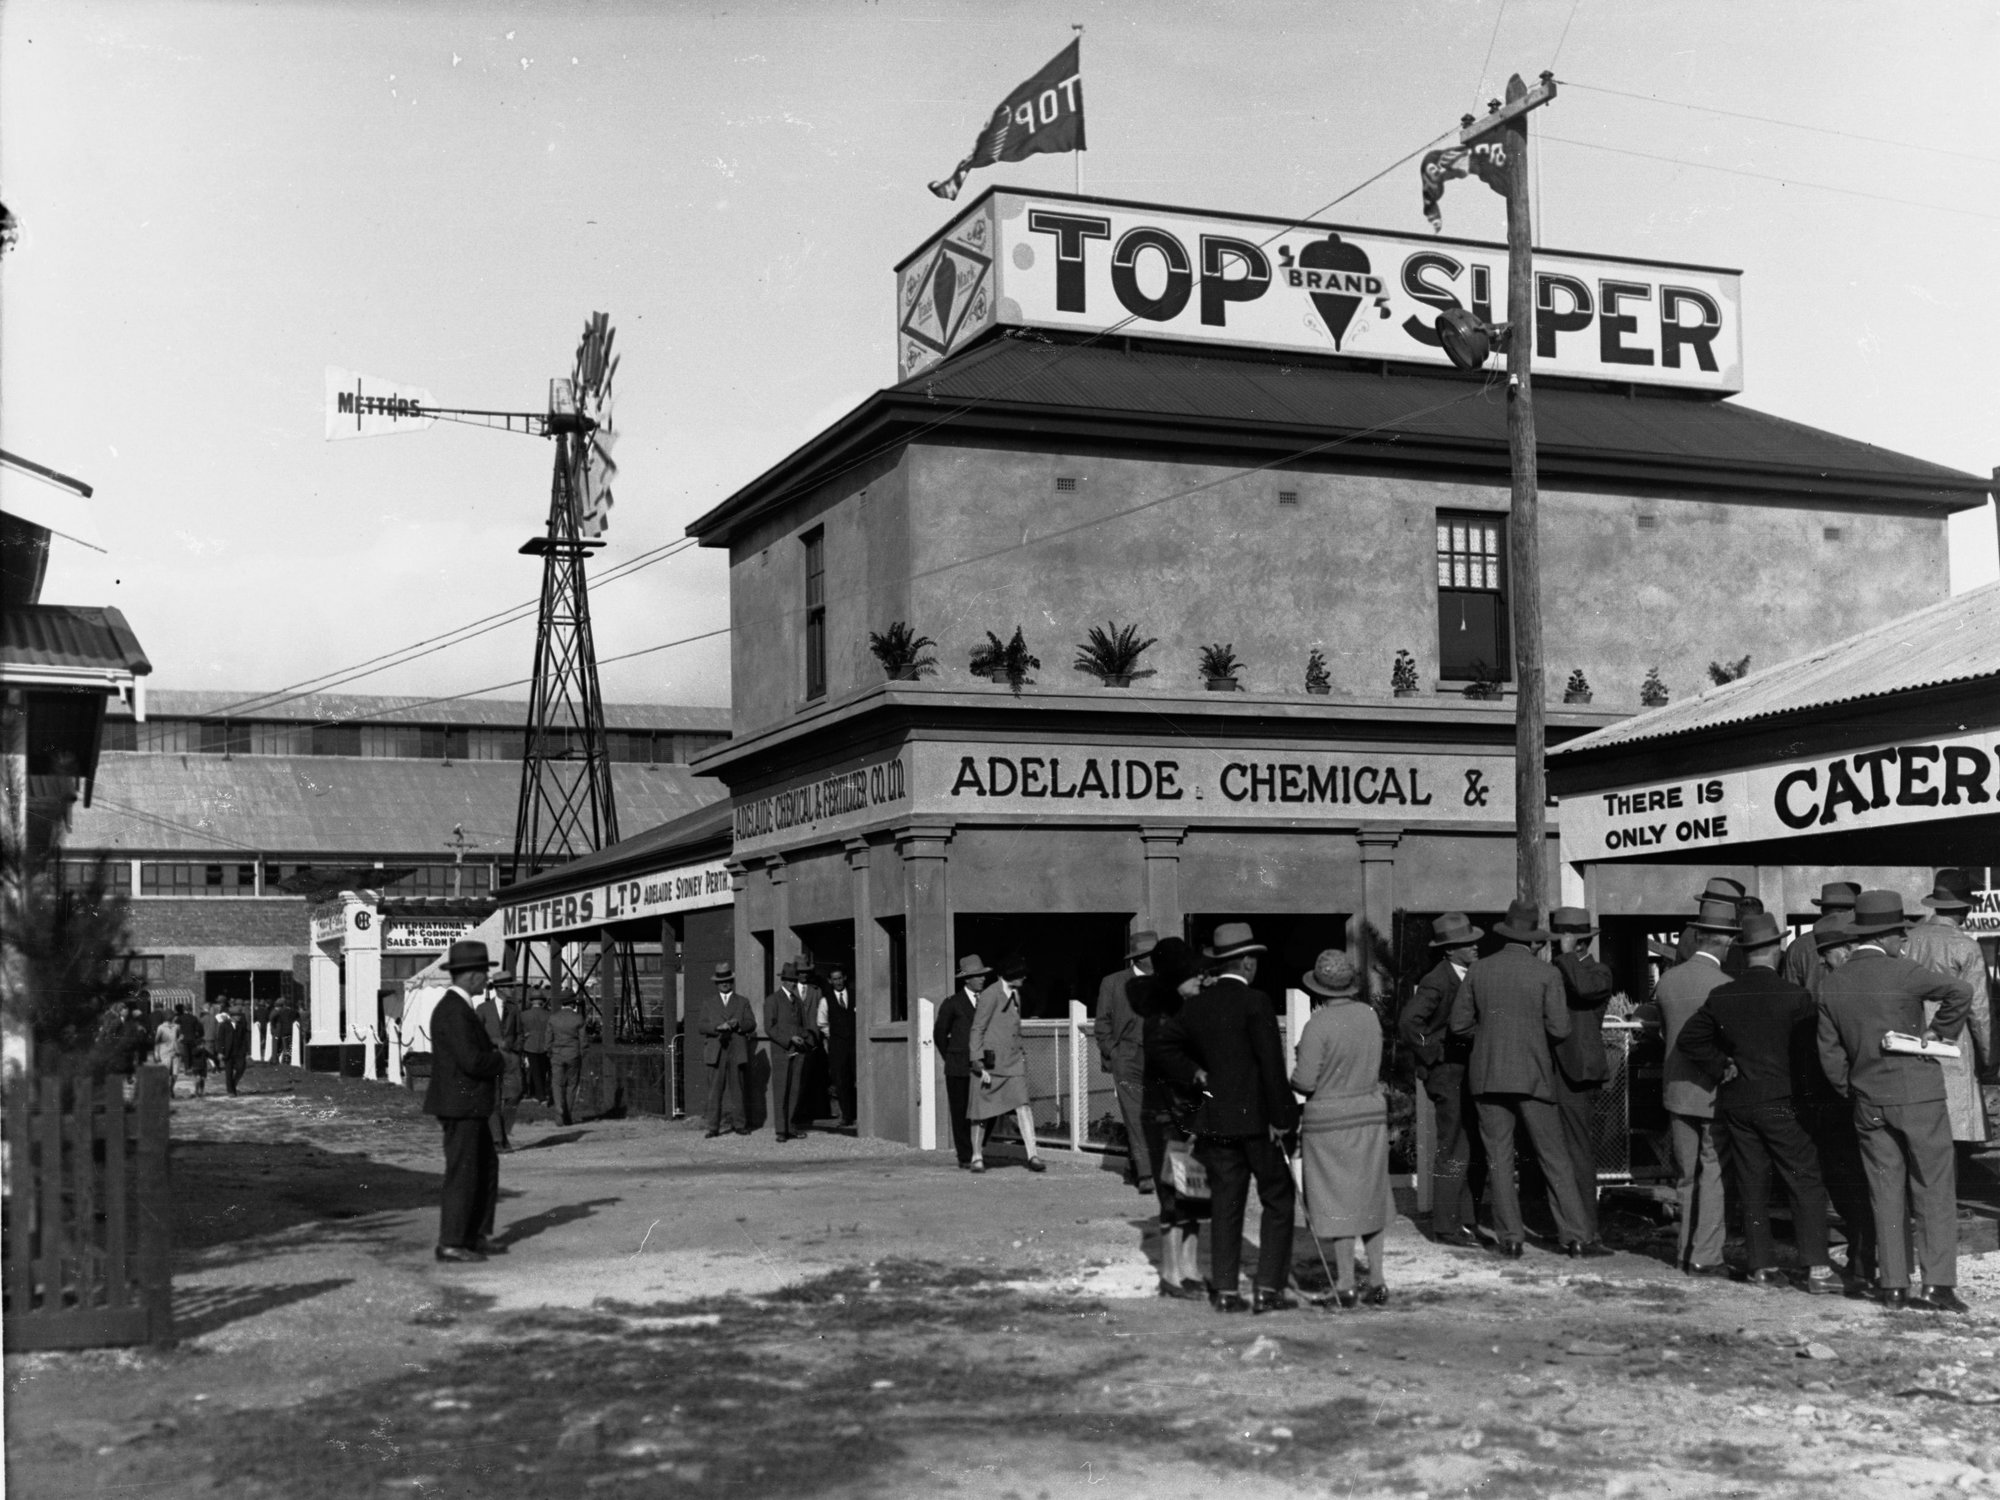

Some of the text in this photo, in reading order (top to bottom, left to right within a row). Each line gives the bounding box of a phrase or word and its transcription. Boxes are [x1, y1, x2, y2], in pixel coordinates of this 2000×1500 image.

[1029, 208, 1272, 327] TOP
[1288, 269, 1382, 294] BRAND
[338, 392, 420, 417] METTERS
[951, 757, 1490, 807] ADELAIDE CHEMICAL &
[1604, 780, 1724, 816] THERE IS
[1774, 744, 2000, 830] CATER
[735, 798, 774, 841] ADELAIDE
[774, 786, 813, 830] CHEMICAL
[1605, 816, 1728, 850] ONLY ONE
[389, 921, 467, 930] INTERNATIONAL
[503, 891, 594, 936] METTERS
[644, 880, 672, 906] ADELAIDE
[676, 875, 702, 900] SYDNEY
